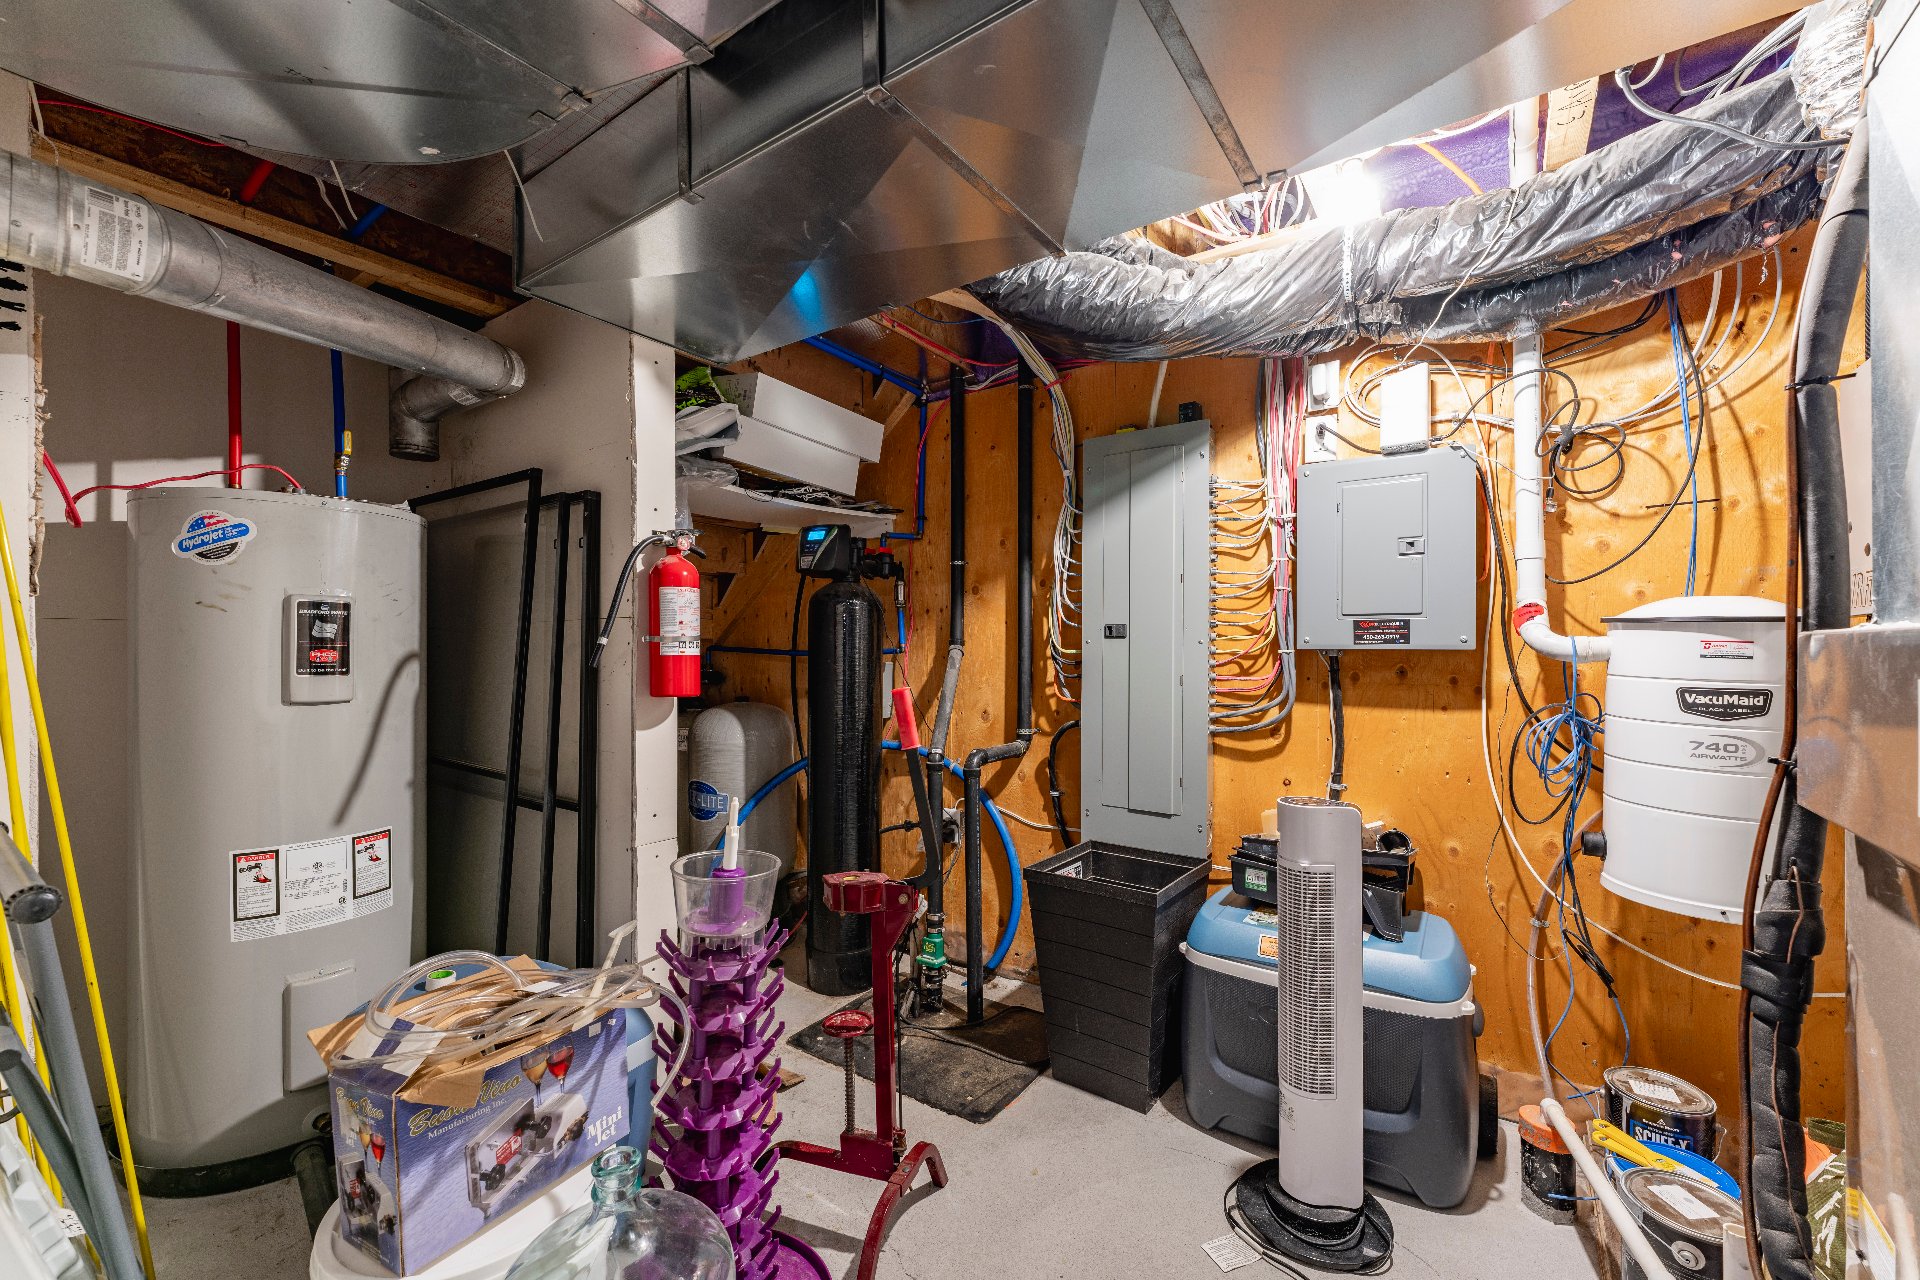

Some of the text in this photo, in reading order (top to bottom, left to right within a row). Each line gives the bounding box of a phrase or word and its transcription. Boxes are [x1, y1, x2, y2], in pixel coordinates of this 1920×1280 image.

[182, 529, 224, 549] Hydrojet
[1684, 693, 1764, 705] VacuMaid
[1689, 741, 1740, 754] 740
[1689, 753, 1748, 761] AIRWATTS
[480, 1074, 522, 1104] Vino
[428, 1098, 507, 1139] Manufacturing Inc.
[587, 1106, 622, 1139] Mini
[594, 1125, 617, 1147] Jet
